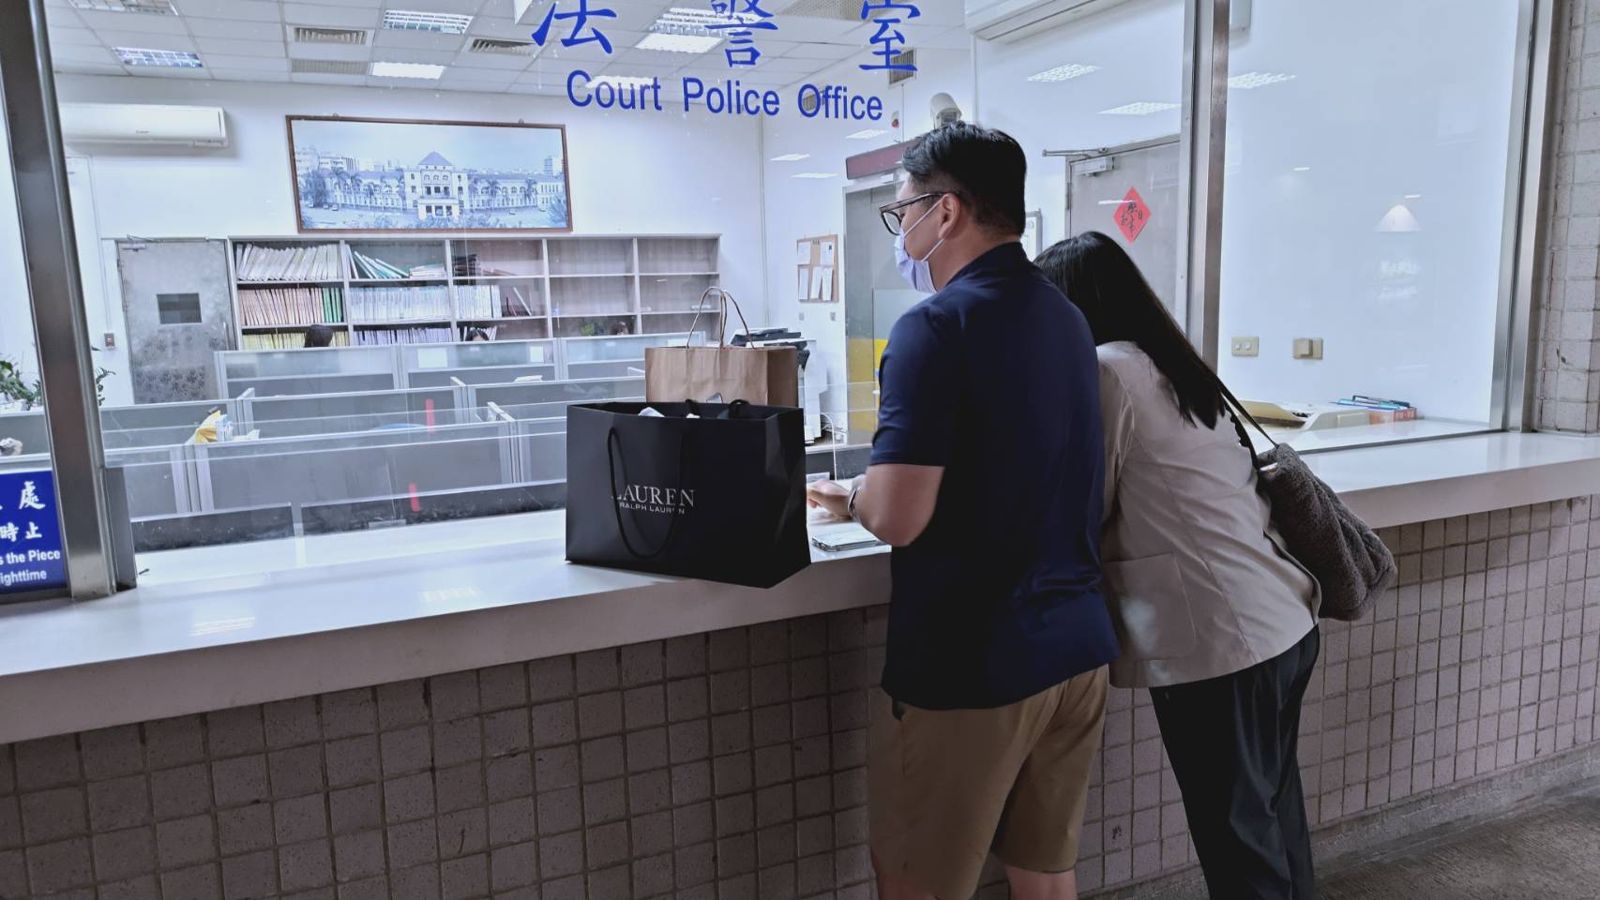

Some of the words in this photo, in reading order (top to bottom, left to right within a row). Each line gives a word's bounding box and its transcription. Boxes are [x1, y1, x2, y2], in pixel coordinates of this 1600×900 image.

[566, 69, 661, 112] Court
[683, 76, 780, 117] Police
[798, 83, 883, 121] Office
[619, 501, 647, 512] RALPH
[650, 504, 686, 515] LAURN
[6, 551, 25, 564] the
[28, 549, 60, 562] Piece
[0, 569, 47, 586] ighttime
